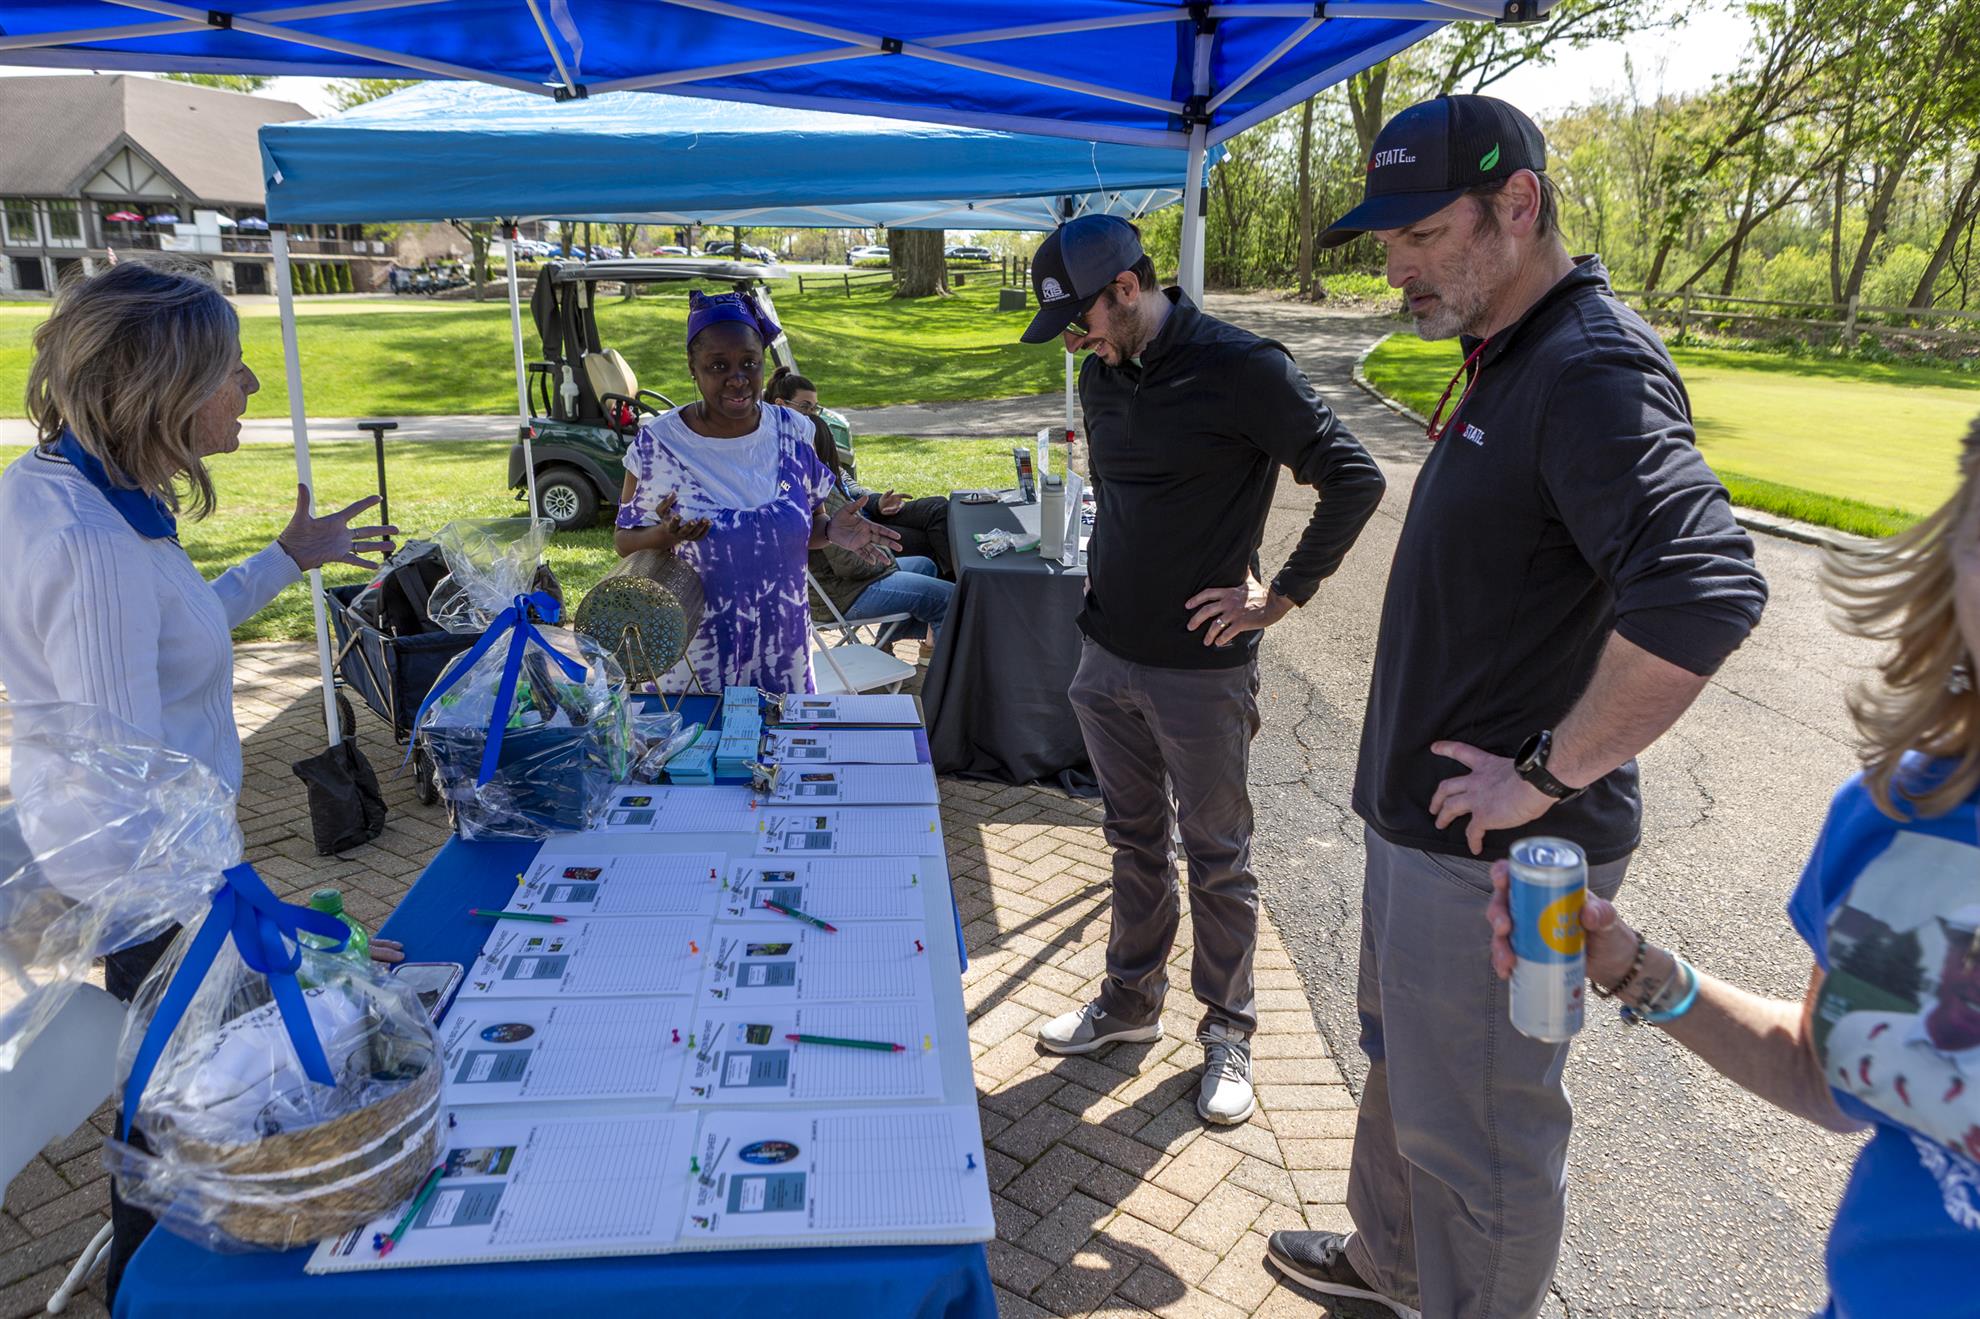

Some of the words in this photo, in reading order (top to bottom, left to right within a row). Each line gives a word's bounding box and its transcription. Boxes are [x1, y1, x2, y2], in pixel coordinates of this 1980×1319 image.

[1375, 148, 1407, 168] STATE
[1405, 155, 1417, 163] LLC
[1463, 424, 1485, 446] STATE
